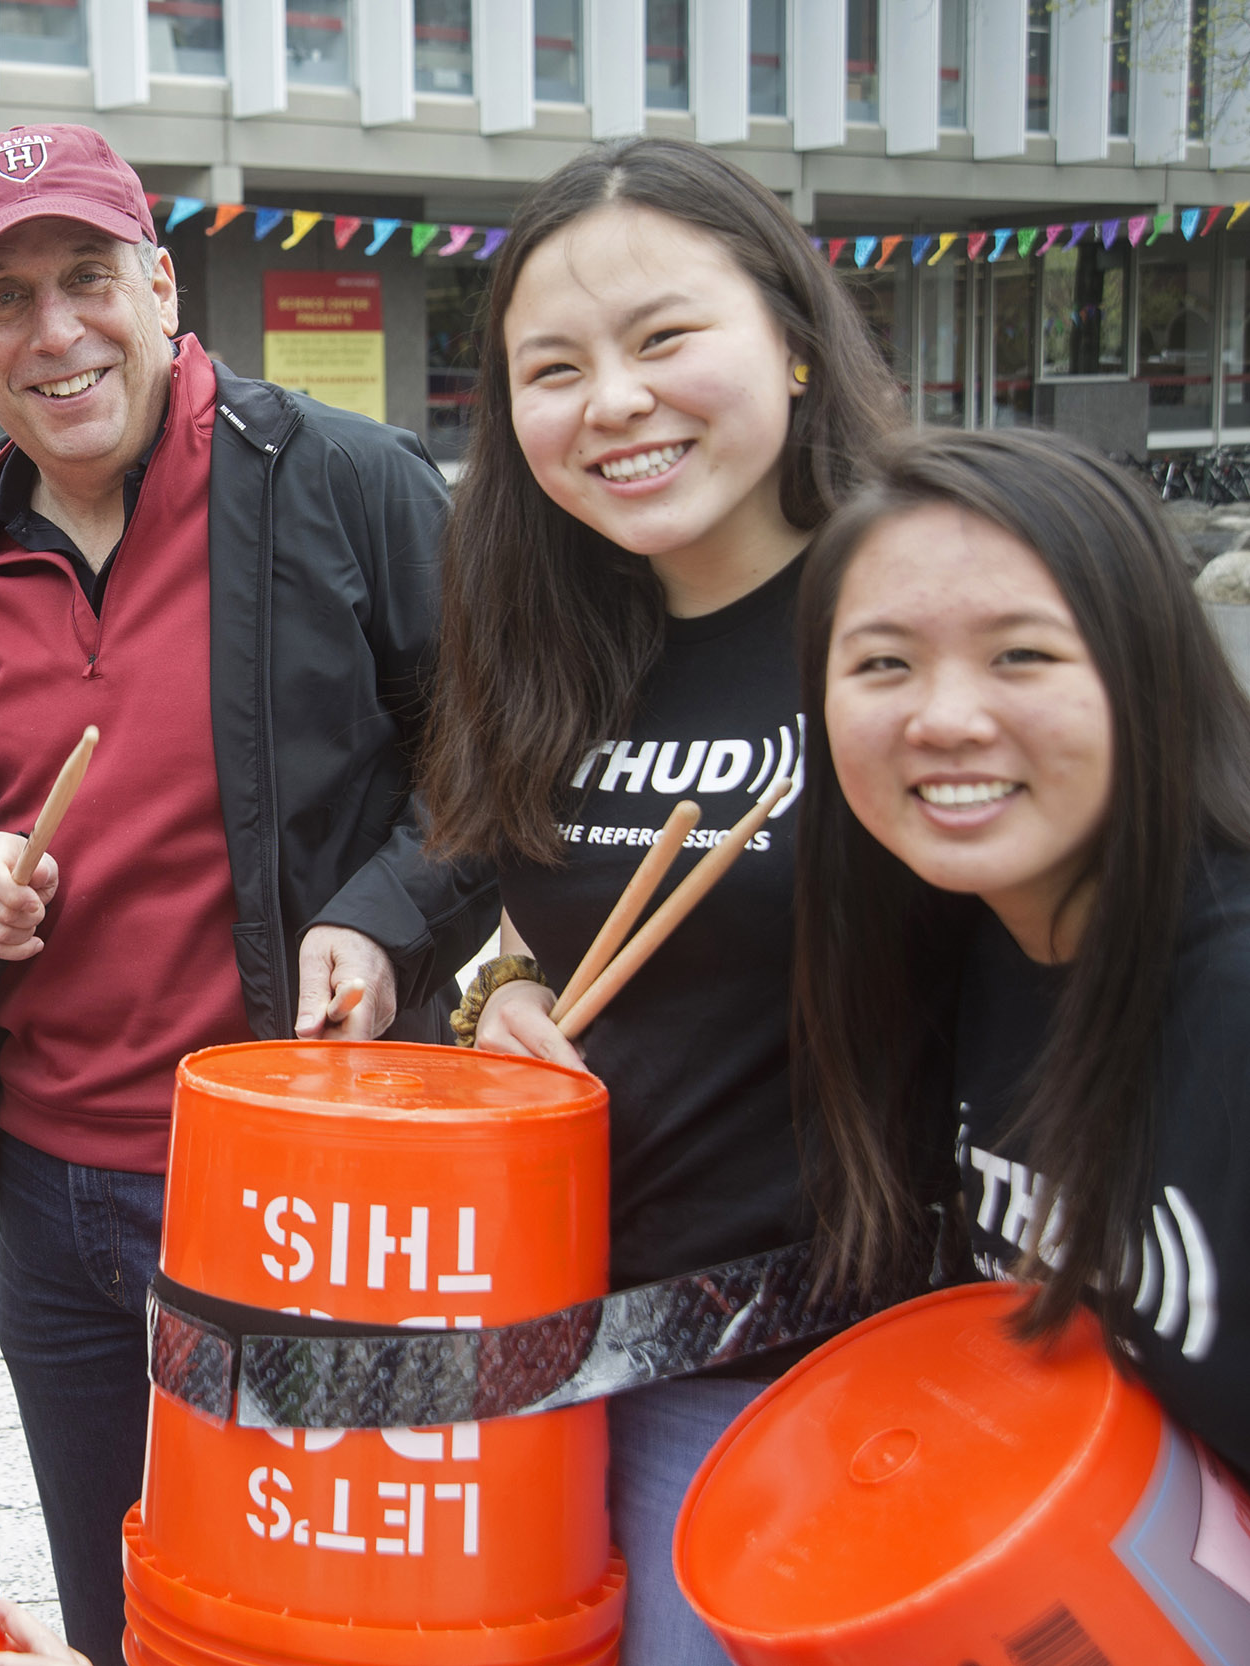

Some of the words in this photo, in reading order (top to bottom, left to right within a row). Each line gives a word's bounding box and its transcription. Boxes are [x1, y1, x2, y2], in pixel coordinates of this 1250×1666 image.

[5, 146, 35, 173] H
[552, 823, 585, 843] HE
[587, 826, 772, 851] REPERCSSIOS
[242, 1188, 492, 1293] THIS.
[246, 1466, 480, 1556] LET'S
